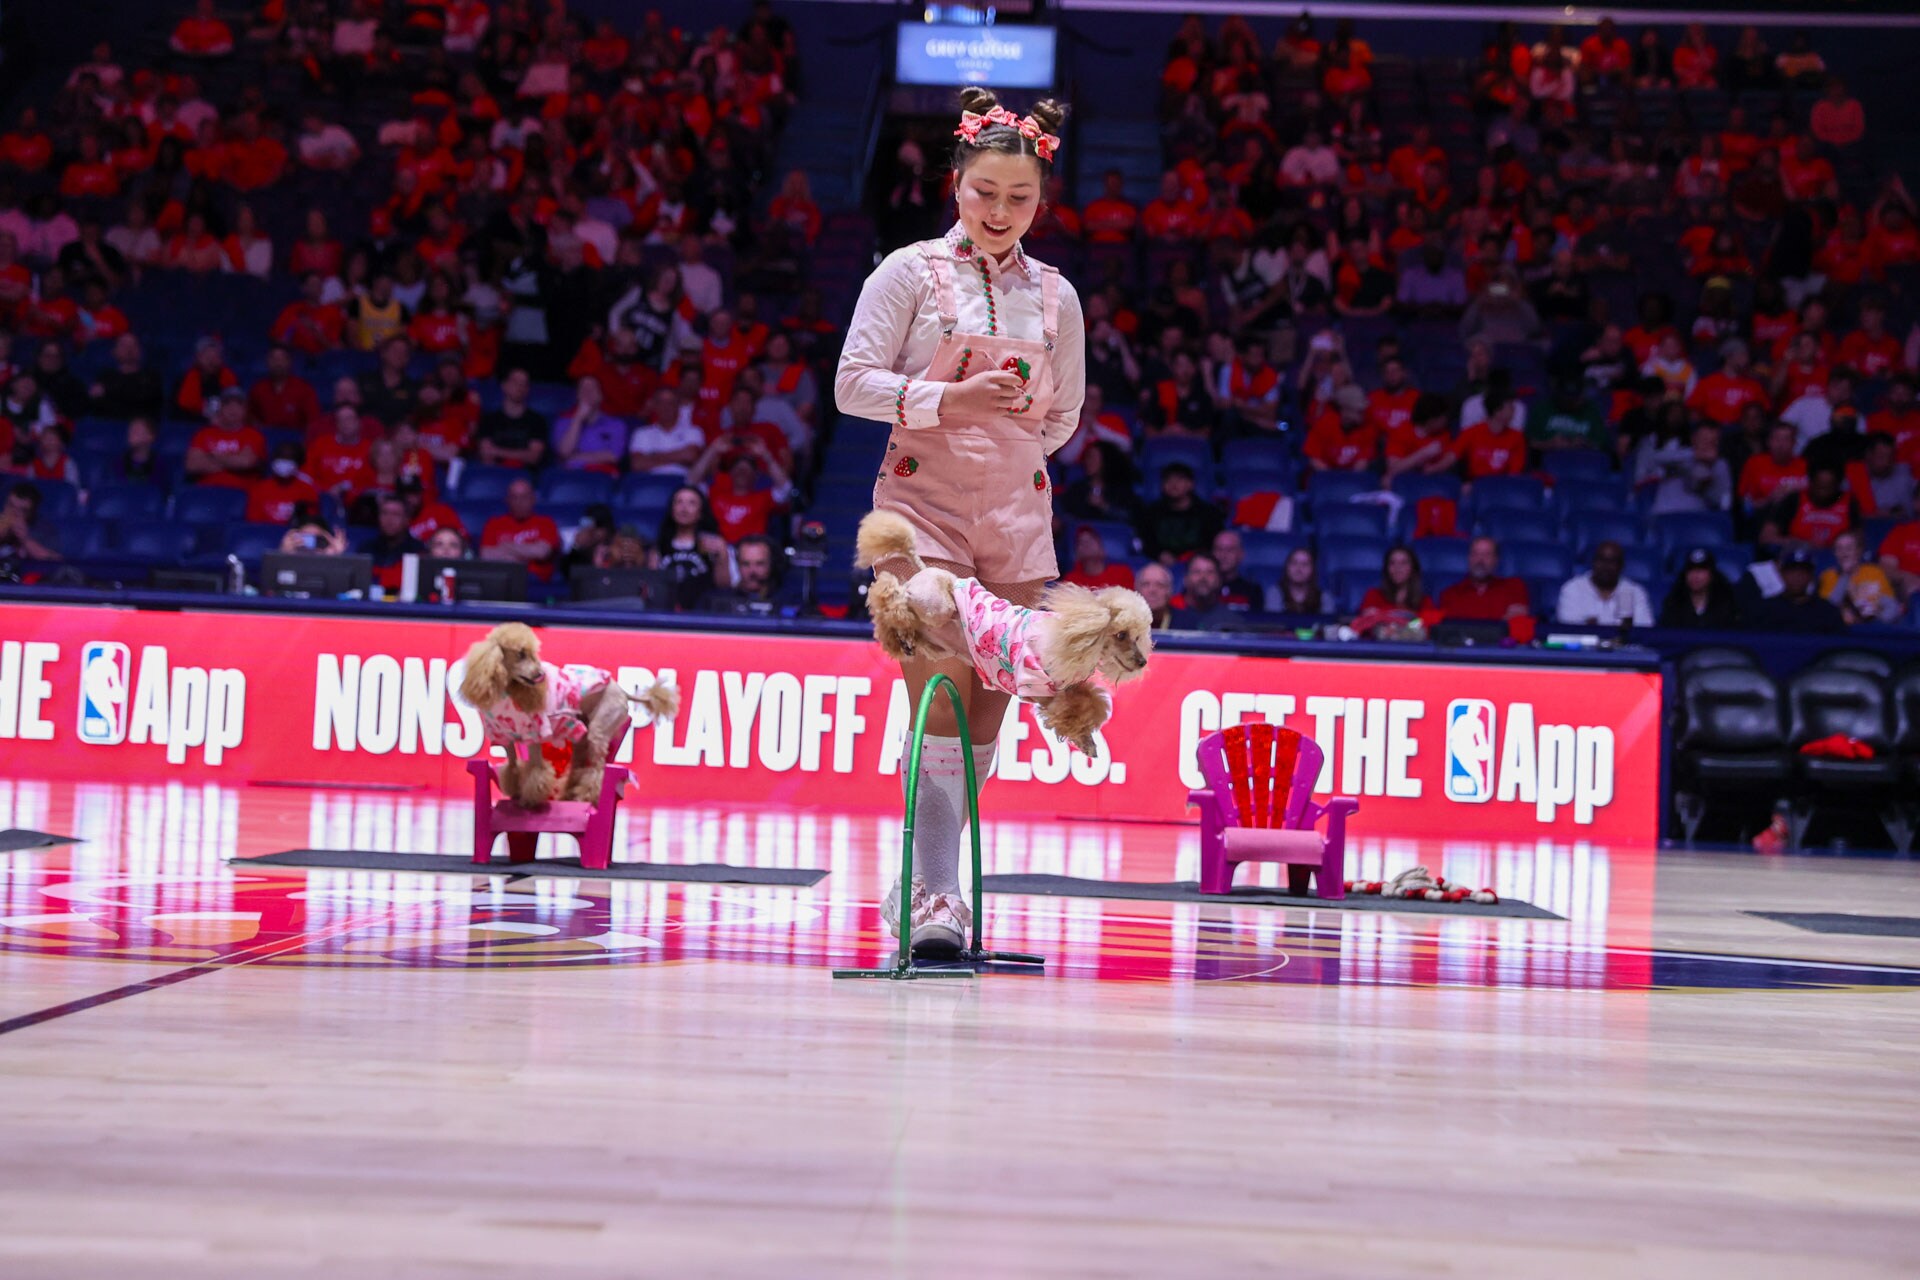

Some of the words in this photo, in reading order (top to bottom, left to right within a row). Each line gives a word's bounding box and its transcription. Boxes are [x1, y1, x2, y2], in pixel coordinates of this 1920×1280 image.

[128, 645, 246, 766] App
[312, 653, 598, 759] NONS
[614, 665, 871, 774] PLAYOFF
[878, 678, 1127, 786] AESS.
[1305, 695, 1425, 798] THE
[1496, 702, 1615, 825] App
